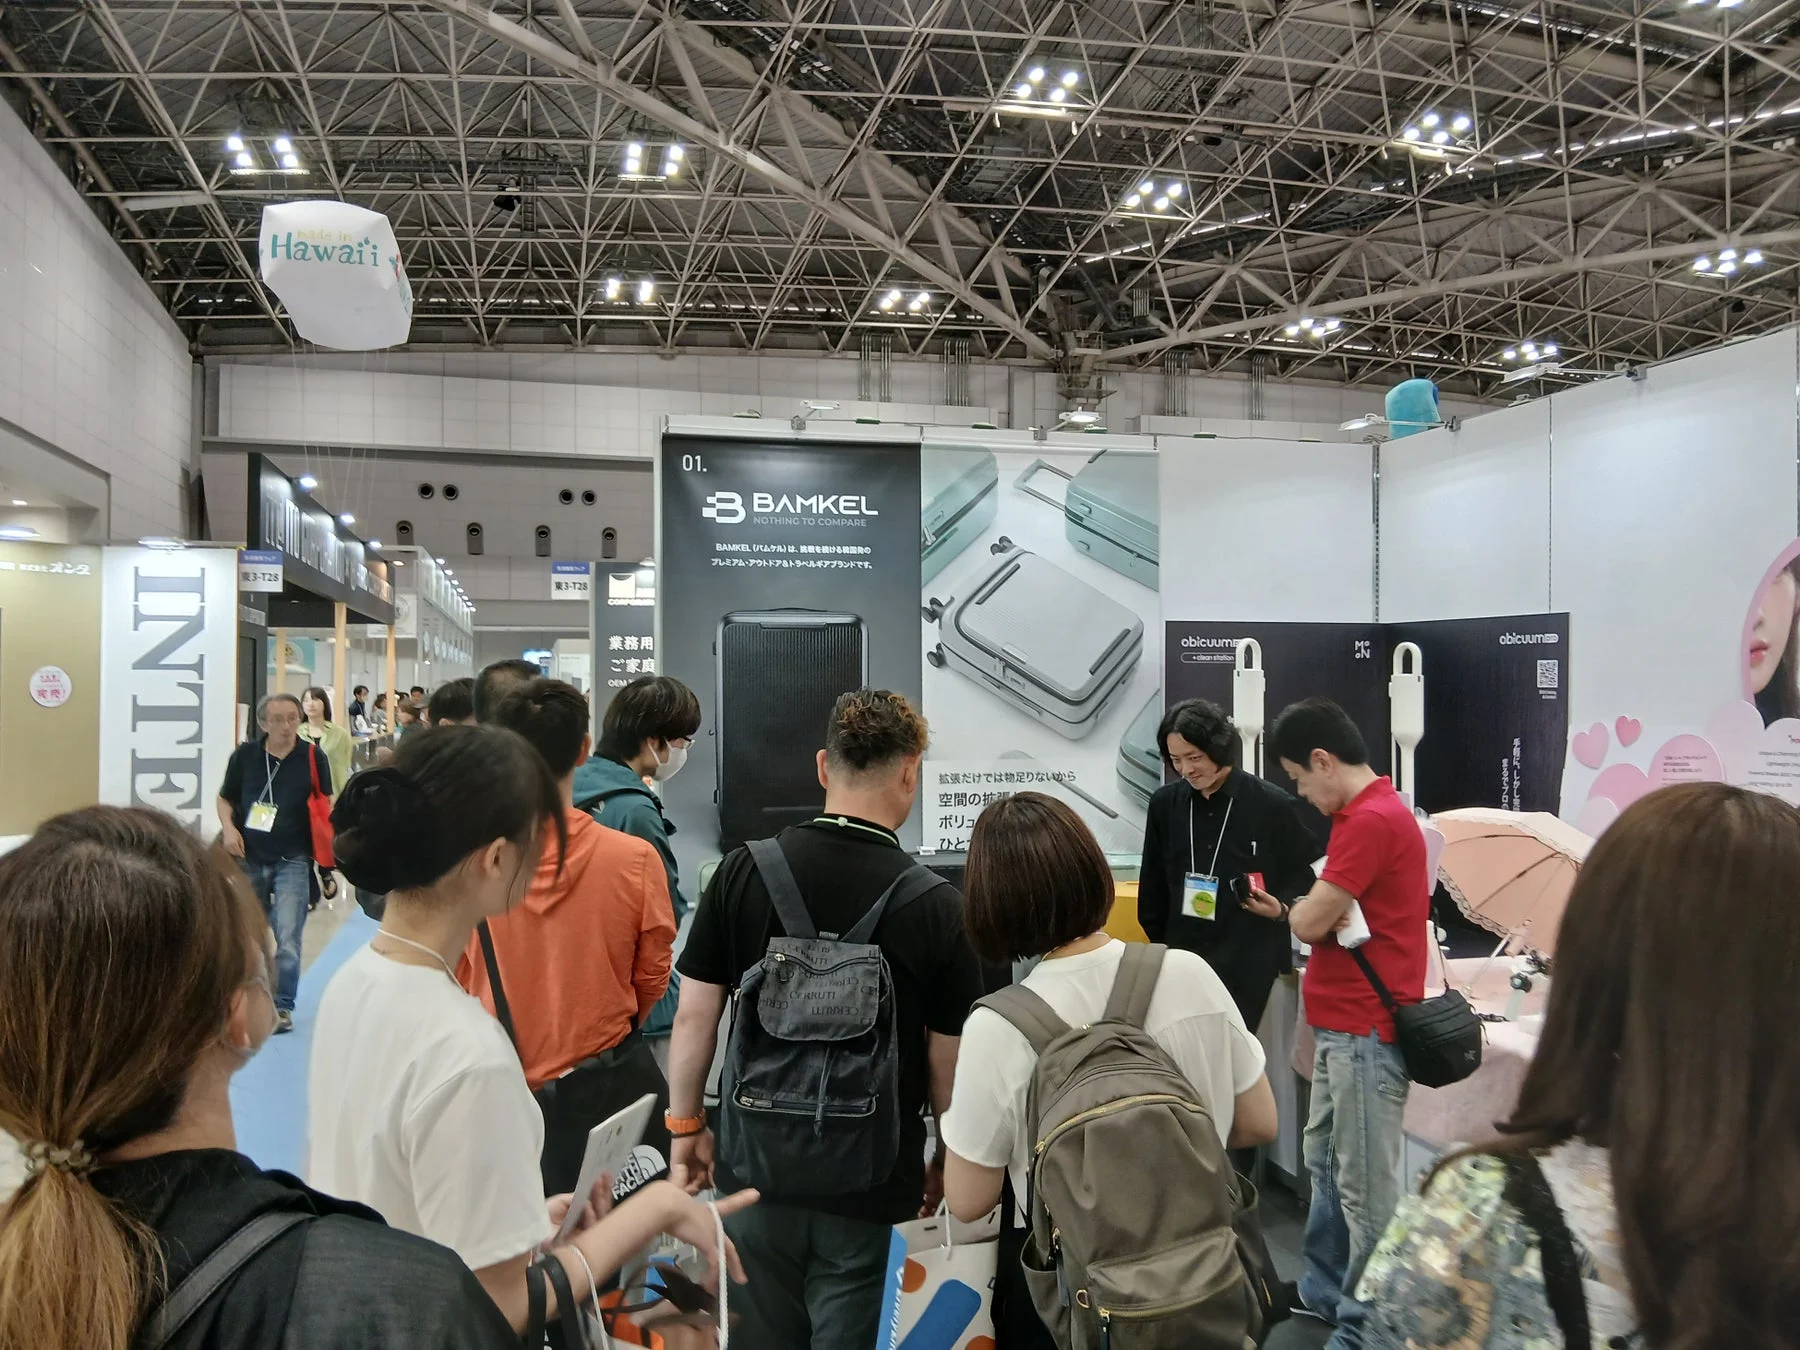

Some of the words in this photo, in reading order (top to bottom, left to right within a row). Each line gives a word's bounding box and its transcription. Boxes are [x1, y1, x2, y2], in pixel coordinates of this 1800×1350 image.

[682, 454, 708, 472] 01.
[753, 492, 879, 516] BAMKEL
[753, 516, 800, 526] NOTHING
[802, 518, 816, 527] TO
[818, 518, 867, 528] COMPARE
[715, 542, 752, 552] BAMKEL
[554, 581, 589, 591] 東3-T28
[131, 566, 206, 836] INTE
[938, 770, 1077, 785] 拡張だけでは物足りないから
[789, 990, 836, 1000] CERRUTI
[611, 1173, 646, 1201] FACE
